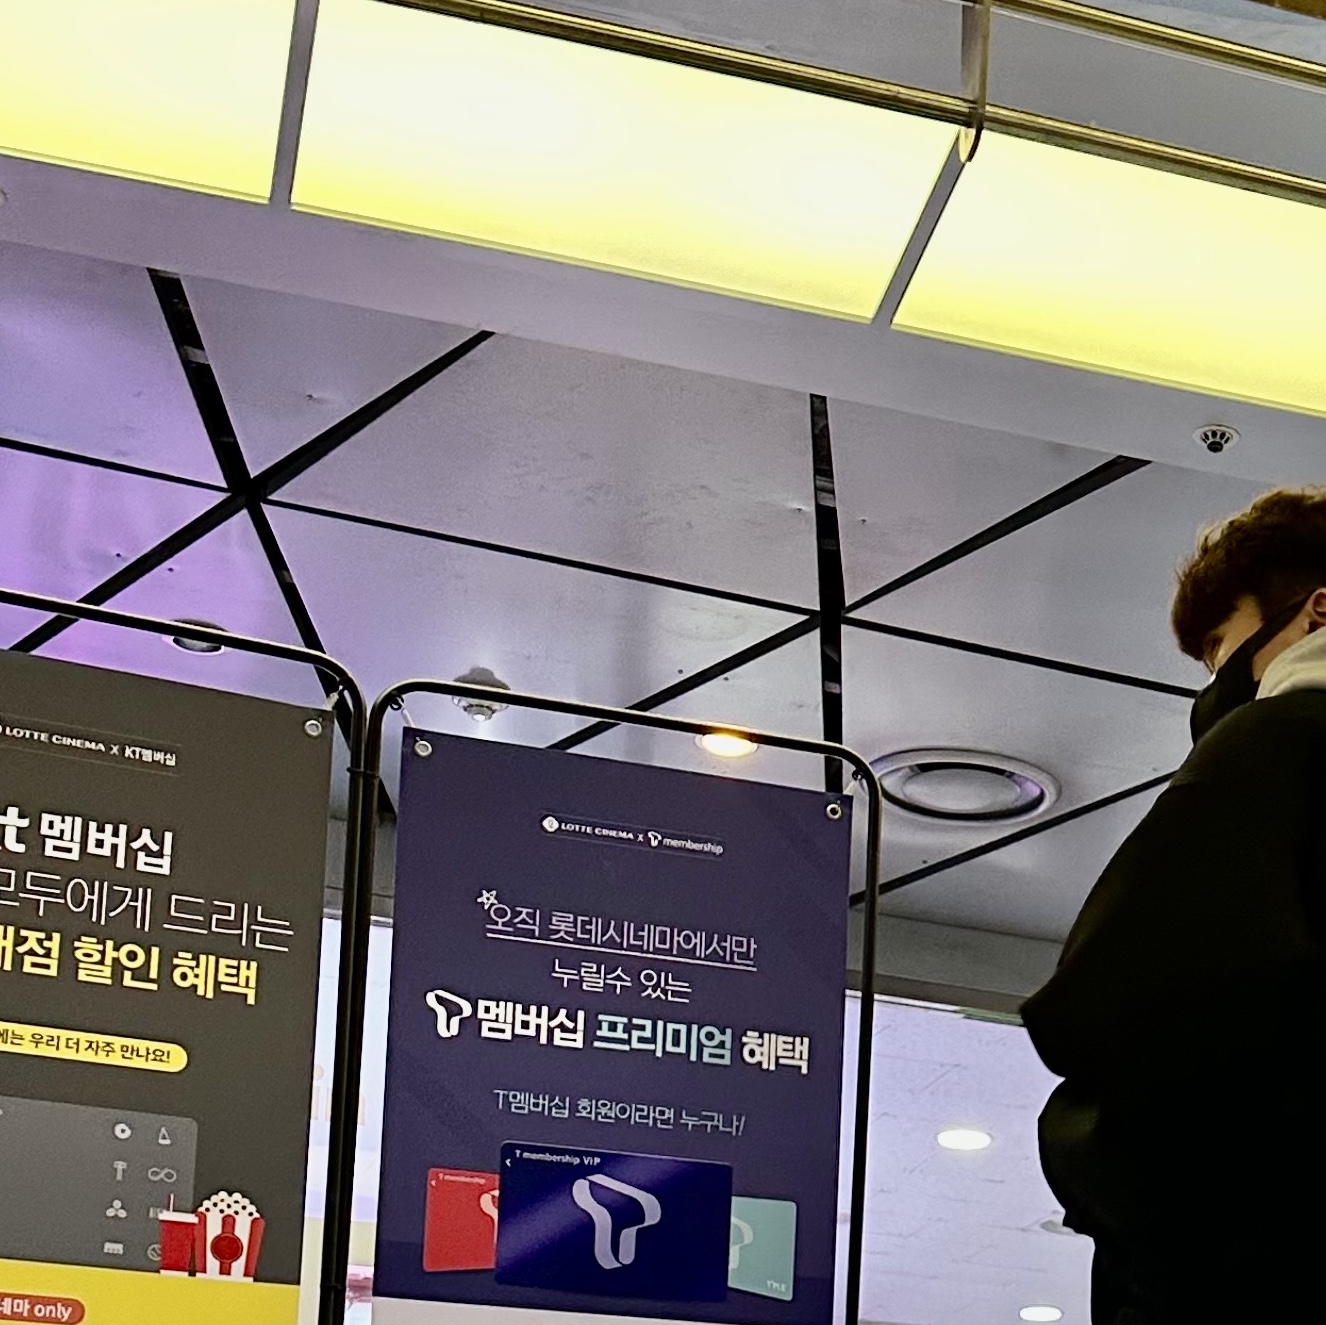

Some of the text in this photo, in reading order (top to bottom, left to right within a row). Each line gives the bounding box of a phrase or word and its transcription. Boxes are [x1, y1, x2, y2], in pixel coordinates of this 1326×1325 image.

[5, 726, 49, 744] LOTTE
[52, 733, 104, 752] CINEMA
[124, 745, 176, 767] KT멤버십
[0, 806, 174, 875] t 멤버십
[561, 822, 593, 835] LOTTE
[595, 826, 634, 841] CINEMA
[663, 836, 724, 856] membership
[163, 894, 294, 952] 드리는
[486, 901, 757, 965] 오직 롯데시네마에서만
[73, 937, 160, 990] 할인
[172, 951, 258, 1005] 혜택
[552, 958, 693, 1002] 누릴수 있는
[29, 1033, 60, 1051] 우리
[65, 1037, 80, 1054] 더
[84, 1039, 116, 1057] 자주
[121, 1045, 170, 1065] 만나요!
[476, 999, 810, 1074] 멤버십 프리미엄 혜택
[494, 1089, 745, 1136] T멤버십 회원이라면 누구나!
[583, 1156, 601, 1166] VIP
[33, 1302, 72, 1321] only
